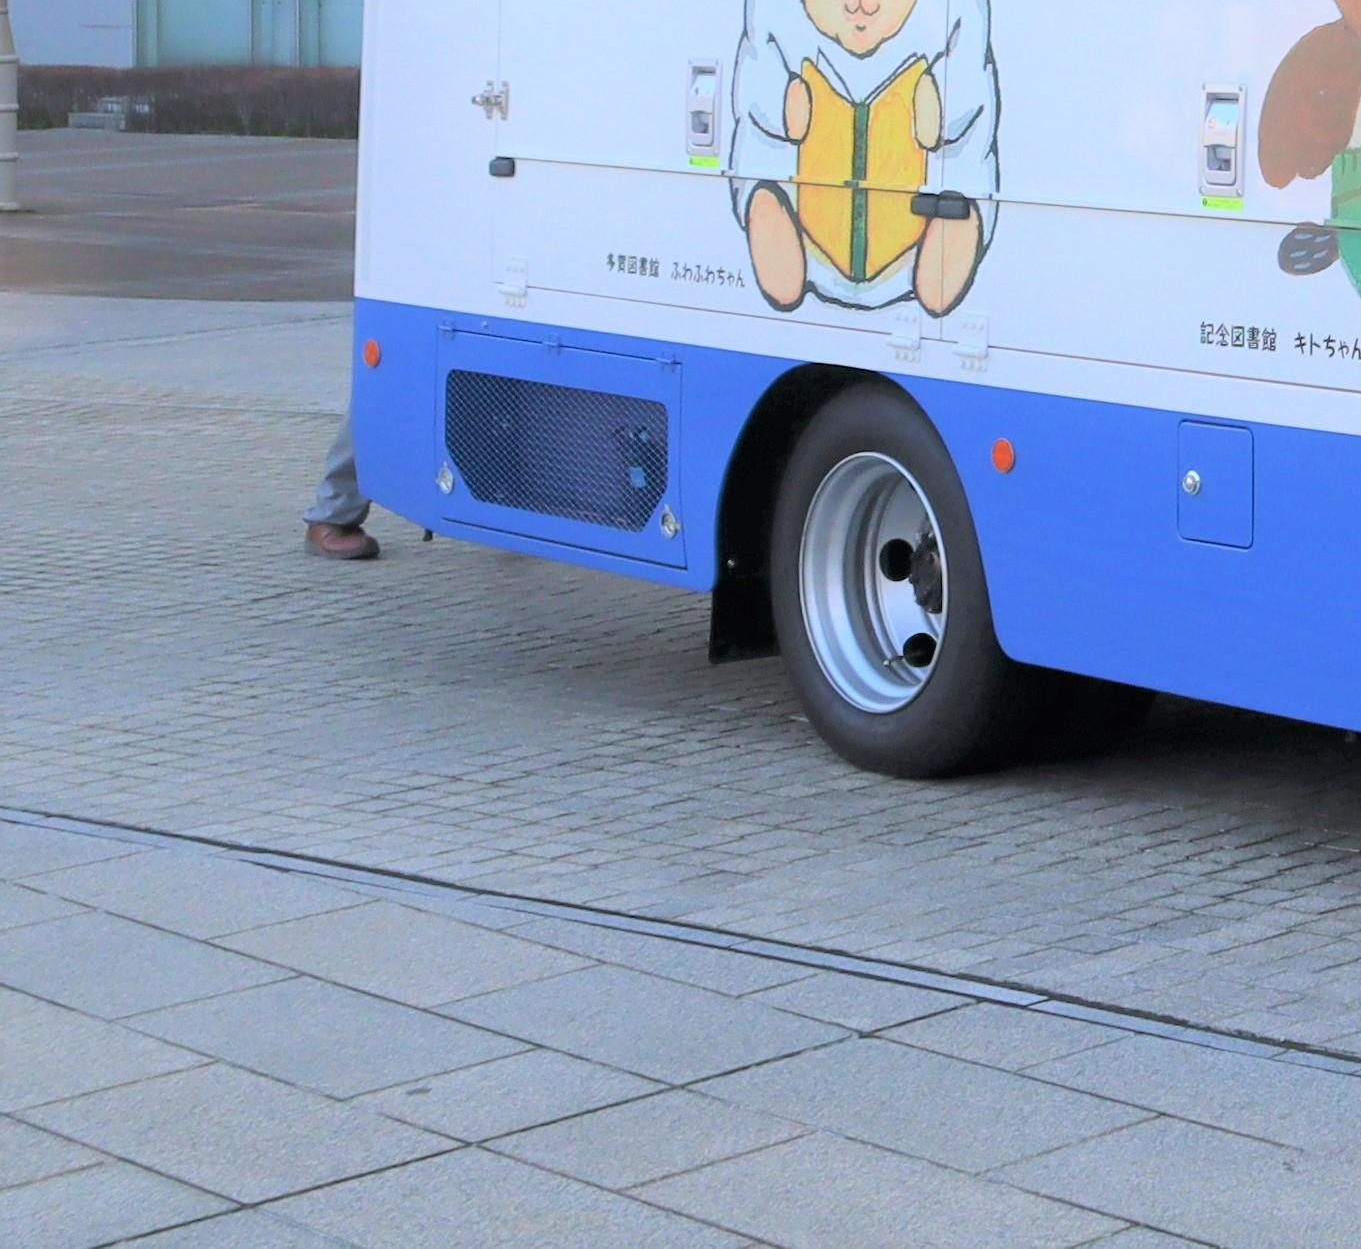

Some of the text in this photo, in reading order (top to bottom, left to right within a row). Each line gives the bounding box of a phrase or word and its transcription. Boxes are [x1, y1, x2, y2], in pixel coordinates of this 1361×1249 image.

[606, 252, 745, 288] 多賀図書館 ふわふわちゃん
[1200, 321, 1278, 352] 記念図書館
